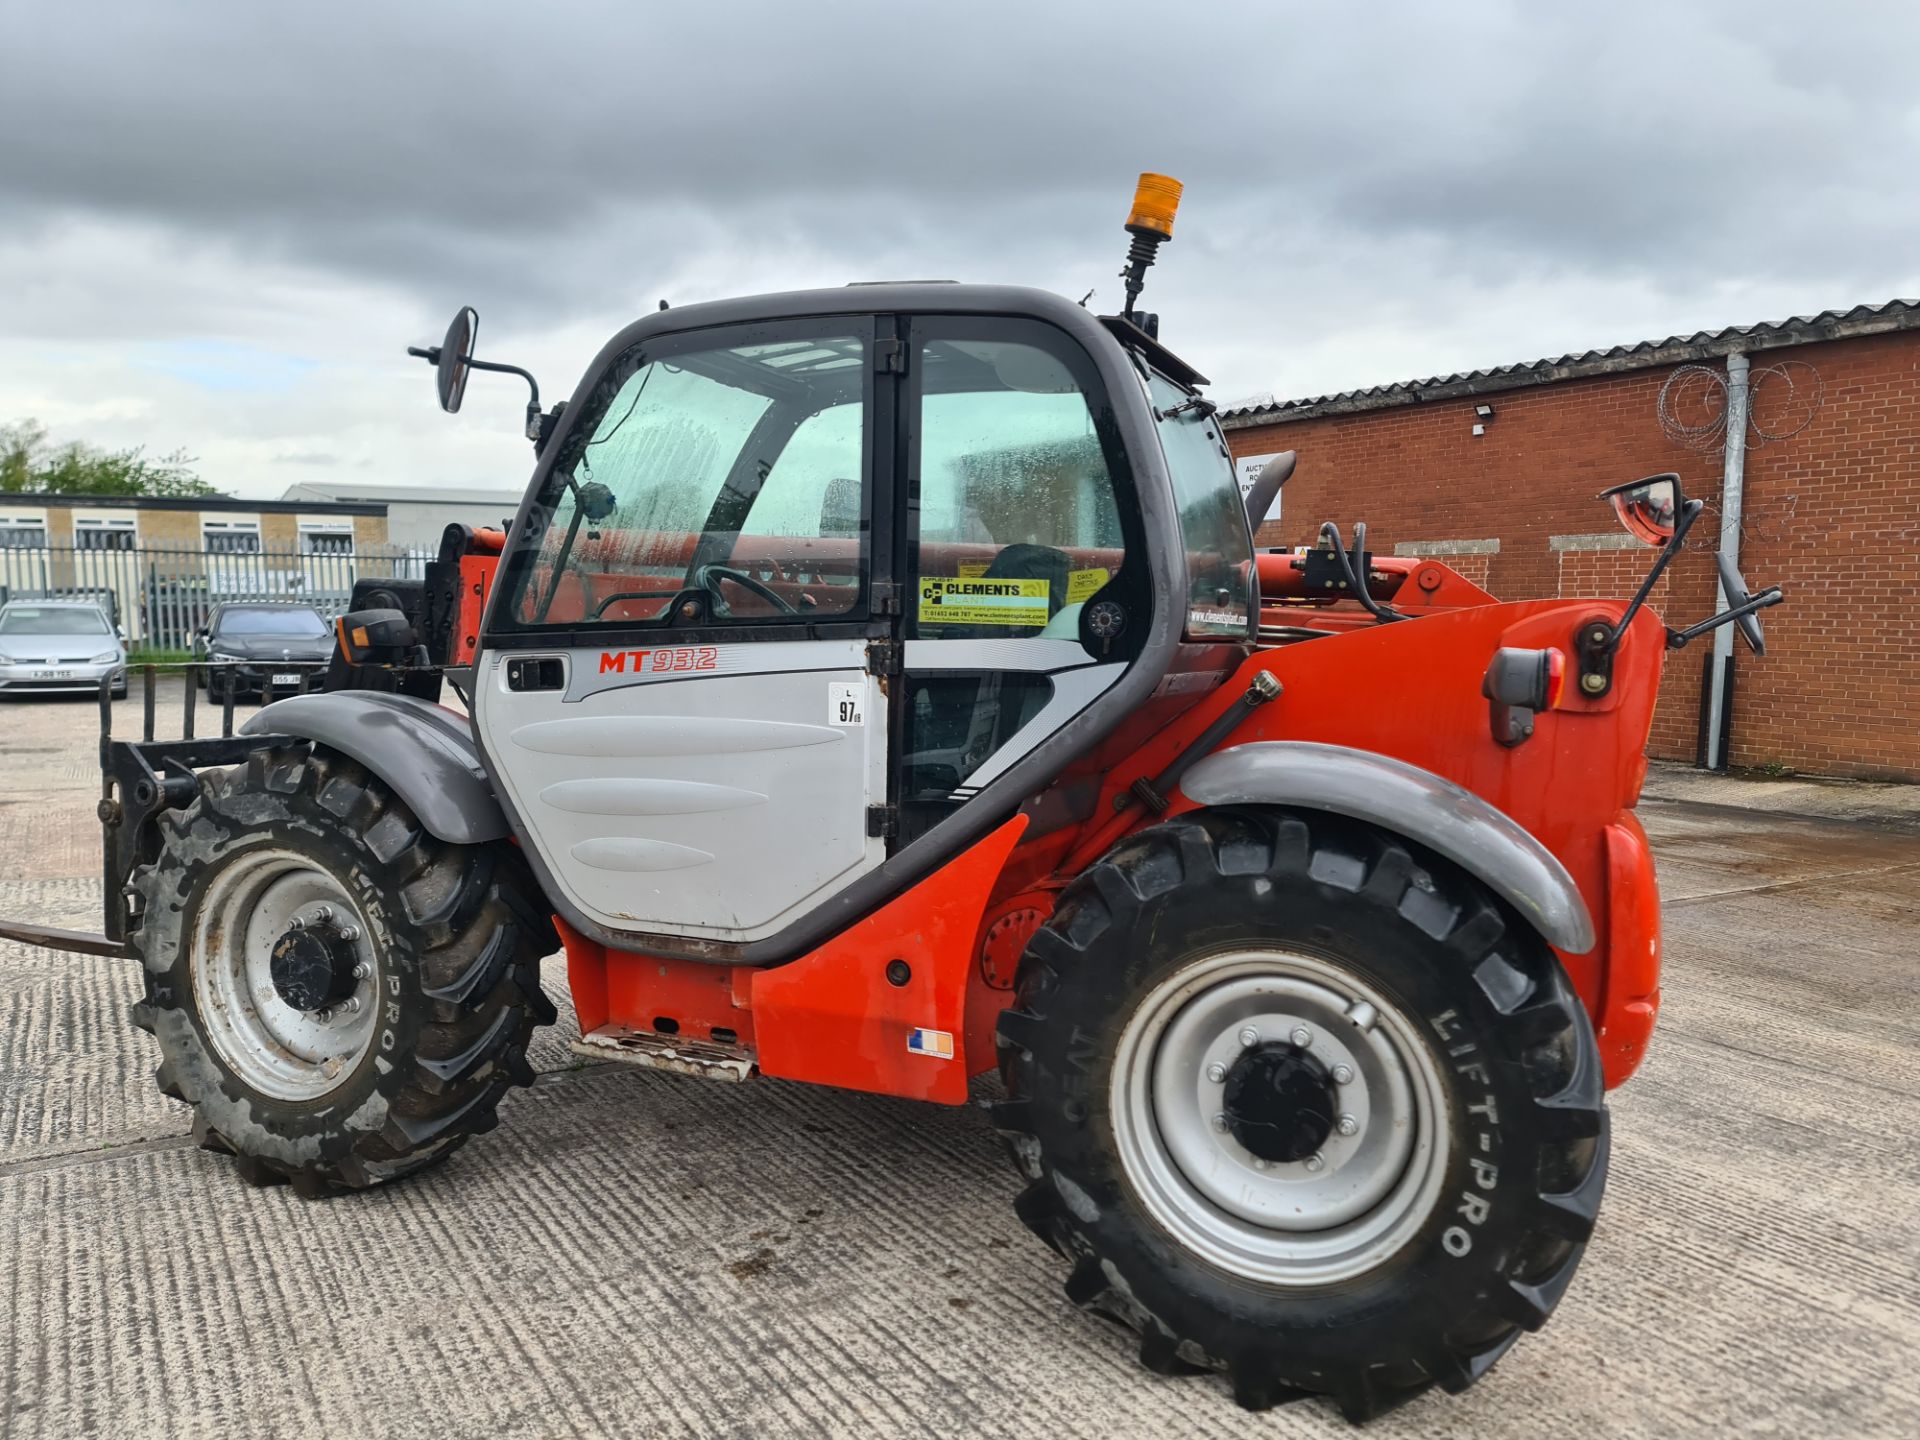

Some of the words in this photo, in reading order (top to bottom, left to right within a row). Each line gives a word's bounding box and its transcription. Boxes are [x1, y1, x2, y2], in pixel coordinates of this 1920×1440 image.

[946, 584, 1020, 596] CLEMENTS
[947, 597, 986, 605] PLANT
[1430, 1009, 1500, 1258] LIFT-PRO
